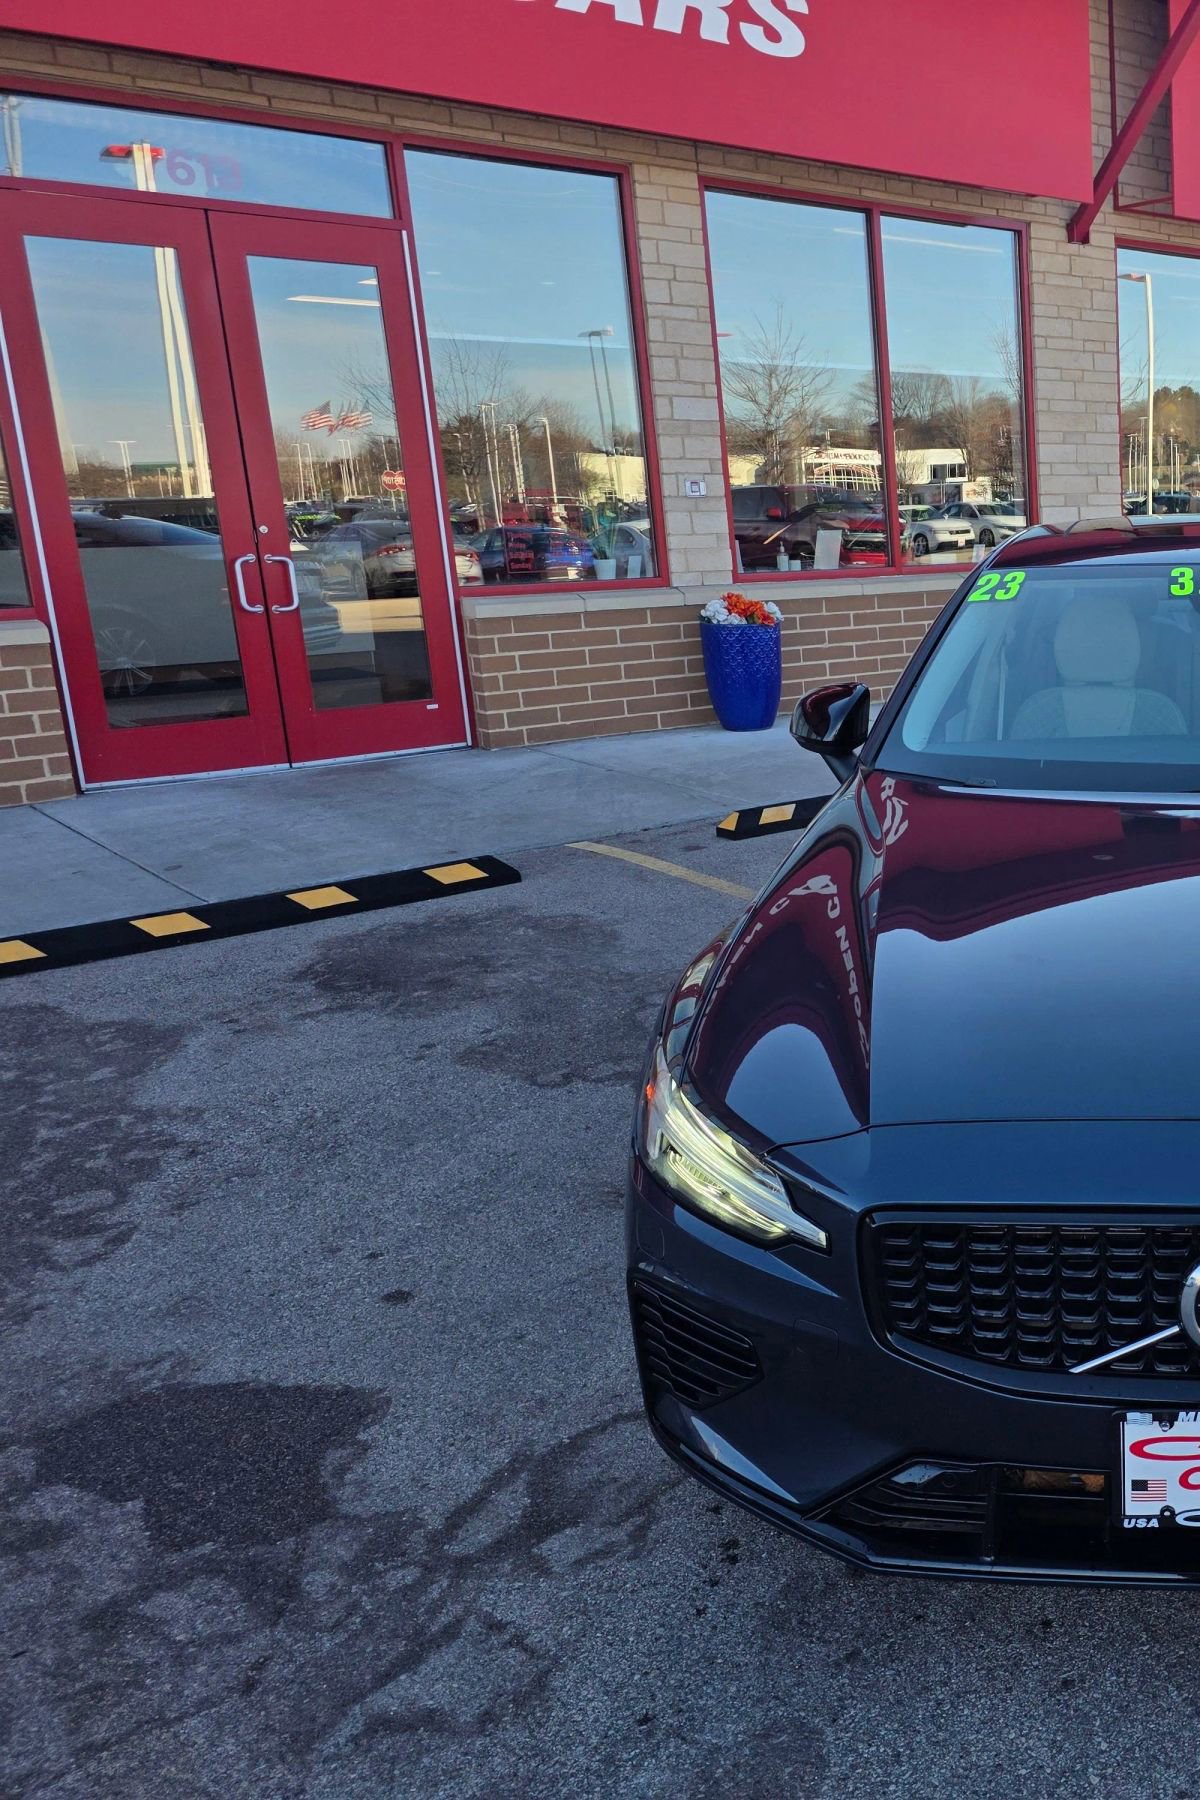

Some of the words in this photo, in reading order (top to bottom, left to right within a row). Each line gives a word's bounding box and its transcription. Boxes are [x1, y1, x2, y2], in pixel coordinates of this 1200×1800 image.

[514, 0, 808, 58] RS
[967, 571, 1026, 602] 23
[1123, 1518, 1159, 1529] USA
